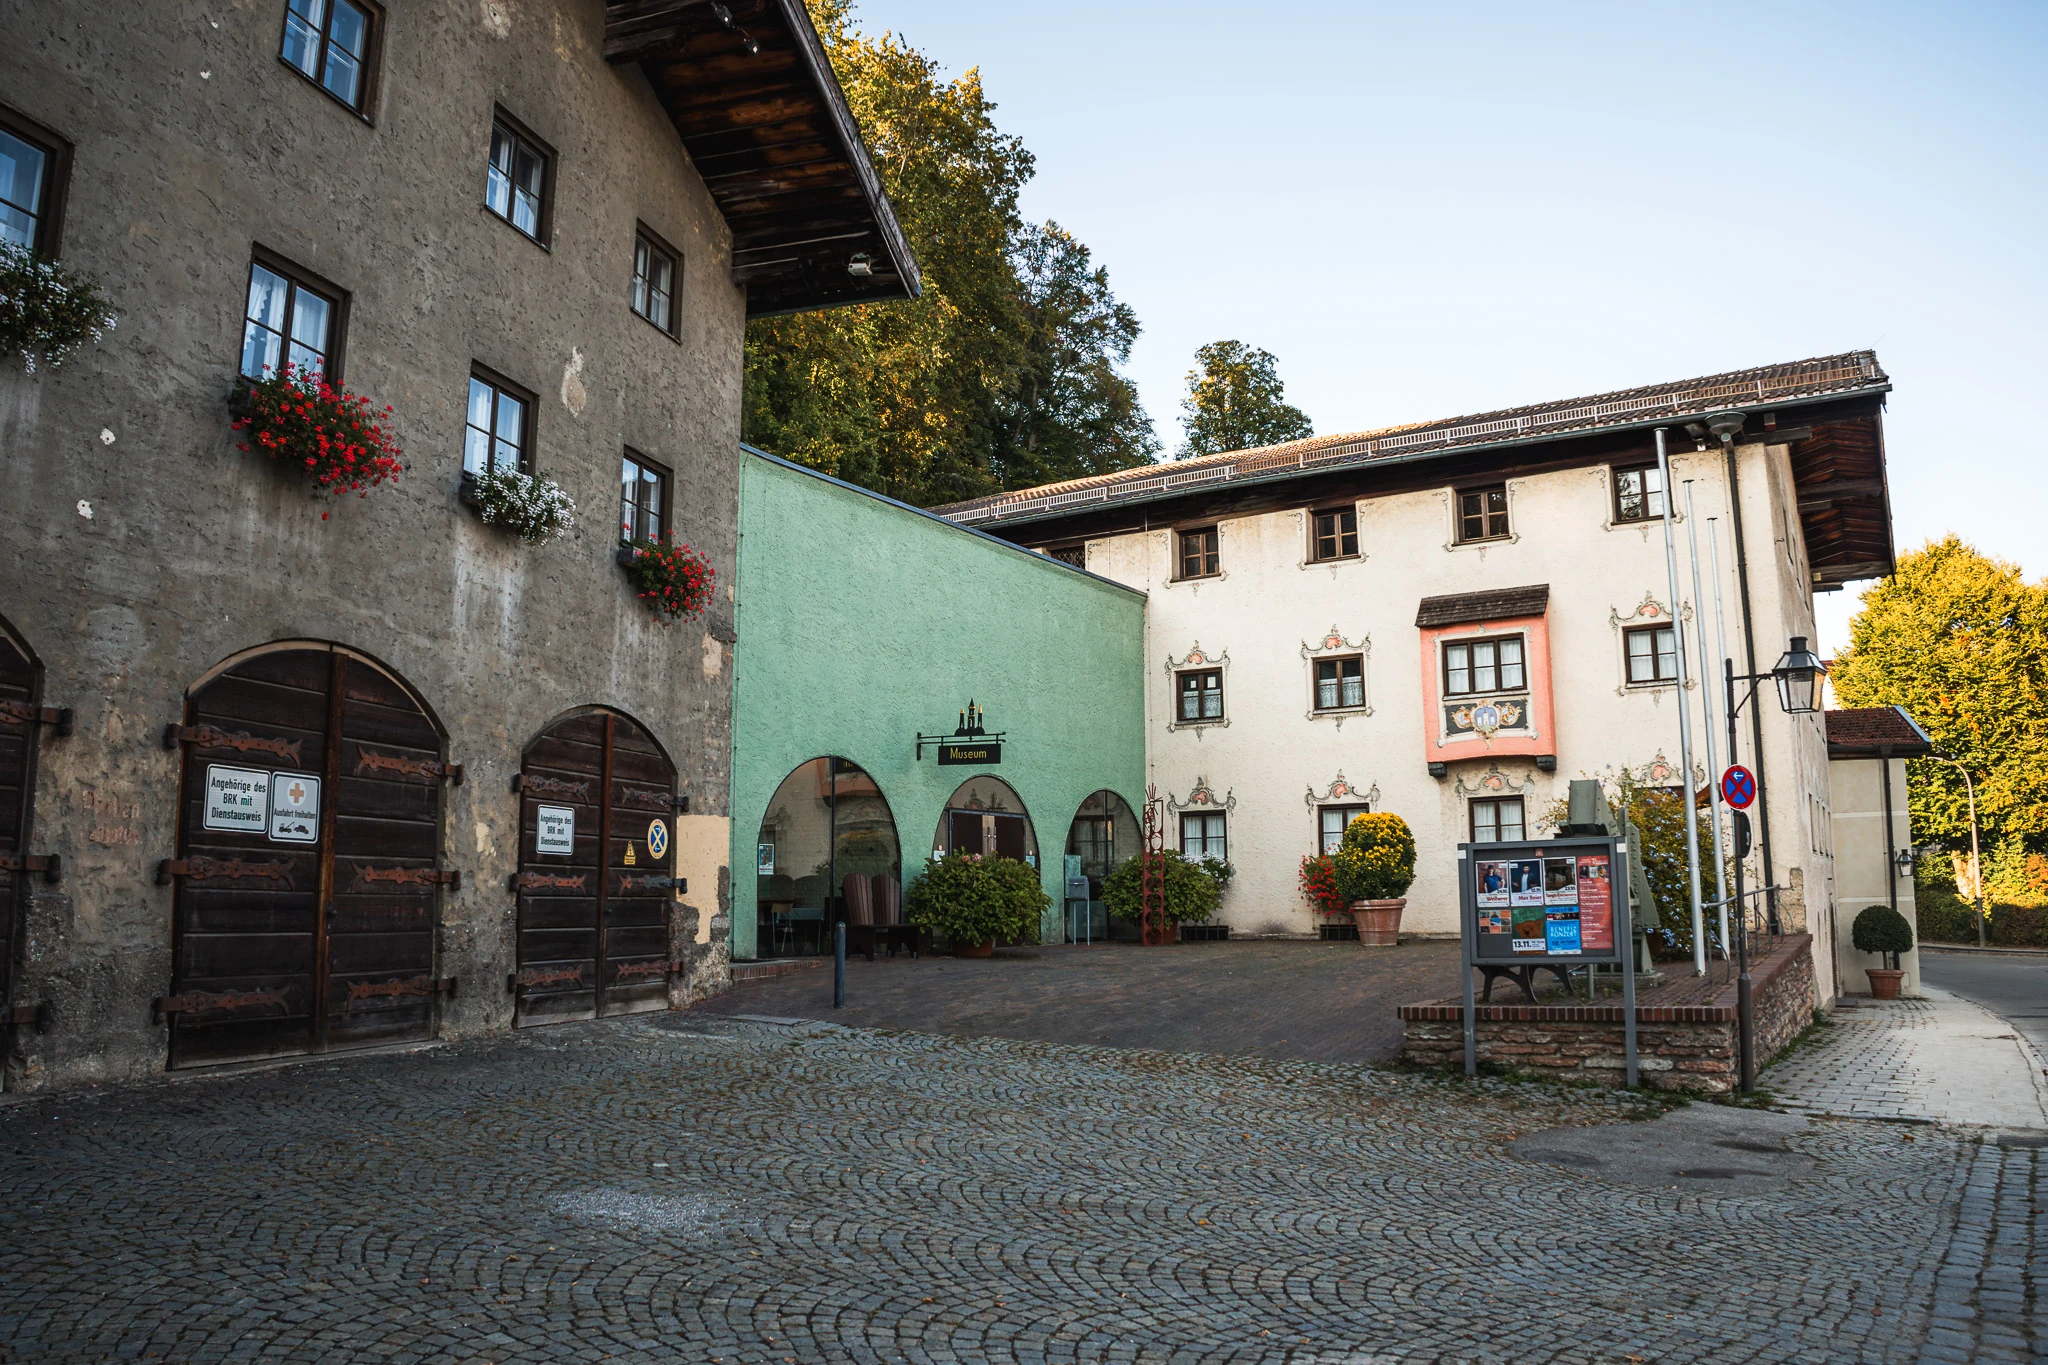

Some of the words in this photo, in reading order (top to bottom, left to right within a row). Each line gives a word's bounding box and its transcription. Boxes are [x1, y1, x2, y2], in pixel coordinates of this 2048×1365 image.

[950, 747, 987, 759] Museum
[211, 776, 251, 793] Angehörige
[253, 782, 266, 793] des
[223, 793, 238, 805] BRK
[240, 796, 253, 806] mit
[211, 807, 262, 822] Dienstausweis
[274, 808, 294, 818] Ausfahrt
[540, 814, 563, 826] Angehörige
[564, 816, 572, 824] des
[557, 827, 565, 835] mit
[540, 836, 570, 846] Dienstausweis
